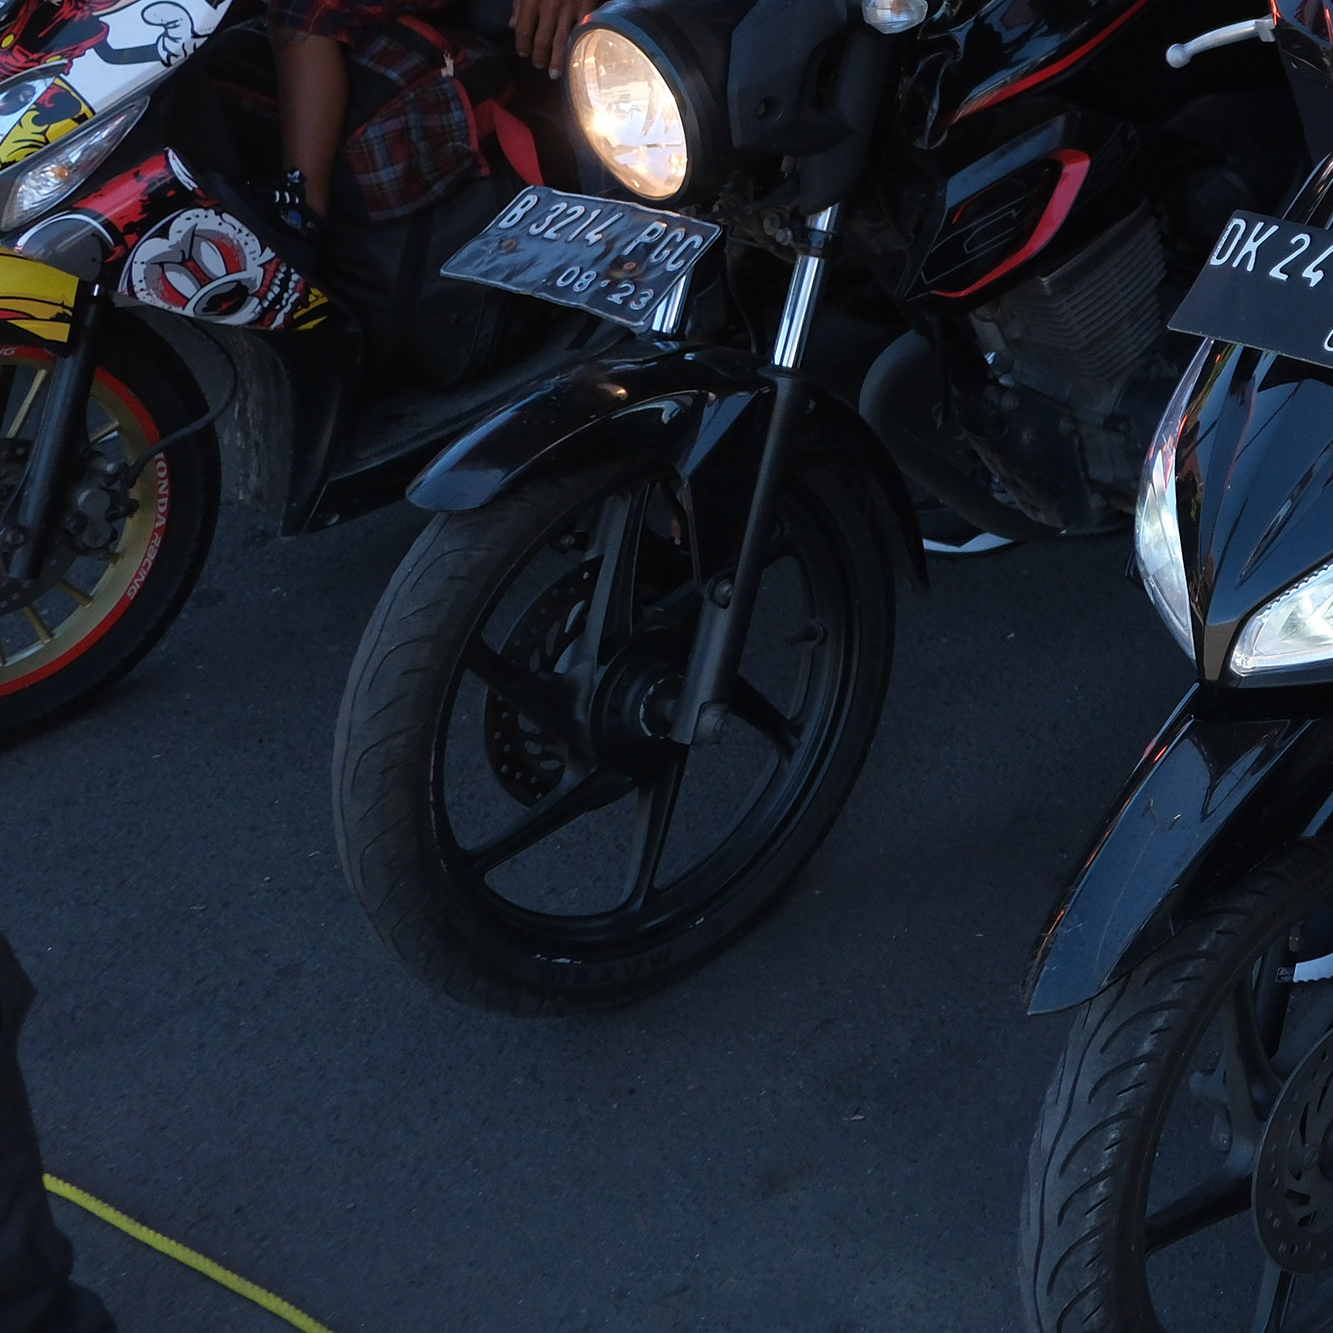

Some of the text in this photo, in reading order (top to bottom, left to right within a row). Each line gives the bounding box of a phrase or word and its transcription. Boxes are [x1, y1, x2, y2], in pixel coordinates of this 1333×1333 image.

[497, 193, 540, 230] B
[528, 201, 626, 247] 3214
[1209, 217, 1280, 272] DK
